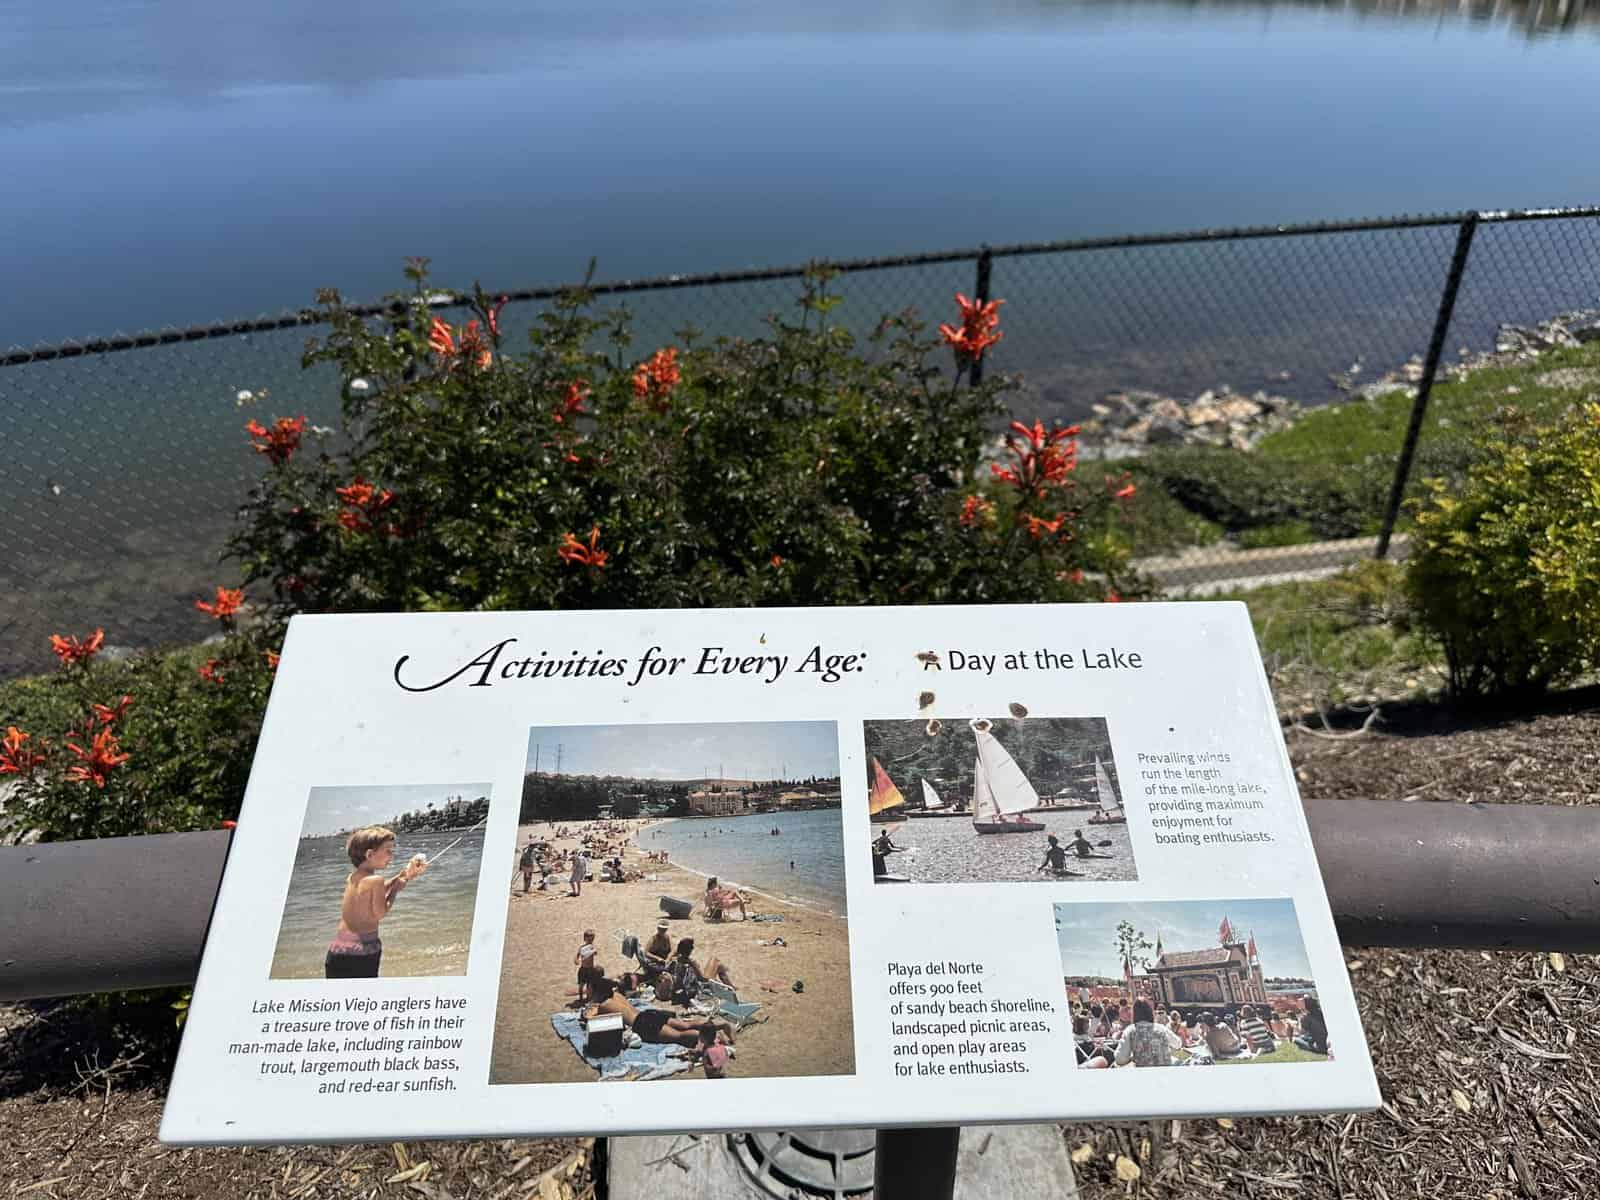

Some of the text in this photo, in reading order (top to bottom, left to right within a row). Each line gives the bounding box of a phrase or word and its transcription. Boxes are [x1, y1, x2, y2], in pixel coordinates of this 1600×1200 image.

[394, 638, 866, 692] Activities for Every Age:
[949, 650, 996, 675] Day
[1005, 652, 1030, 670] at
[1036, 649, 1073, 669] the
[1082, 648, 1142, 669] Lake
[1137, 753, 1195, 765] Prevailing
[1141, 768, 1222, 780] run the length
[1145, 784, 1157, 795] of
[1159, 784, 1178, 795] the
[1181, 783, 1234, 796] mile-long
[1149, 799, 1264, 813] providing maximum
[1152, 815, 1233, 829] enjoyment for
[1155, 832, 1275, 845] boating enthusiasts.
[888, 962, 983, 978] Playa del Norte
[889, 981, 982, 997] offers 900 feet
[252, 997, 466, 1013] Lake Mission Viejo anglers have
[891, 999, 1055, 1016] of sandy beach shoreline,
[261, 1015, 465, 1033] a treasure trove of fish in their
[892, 1019, 1051, 1036] landscaped picnic areas,
[228, 1036, 463, 1054] man-made lake, including rainbow
[893, 1040, 1026, 1057] and open play areas
[260, 1057, 460, 1075] trout, largemouth black bass,
[895, 1060, 1029, 1076] for lake enthusiasts.
[319, 1077, 457, 1093] and red-ear sunfish.
